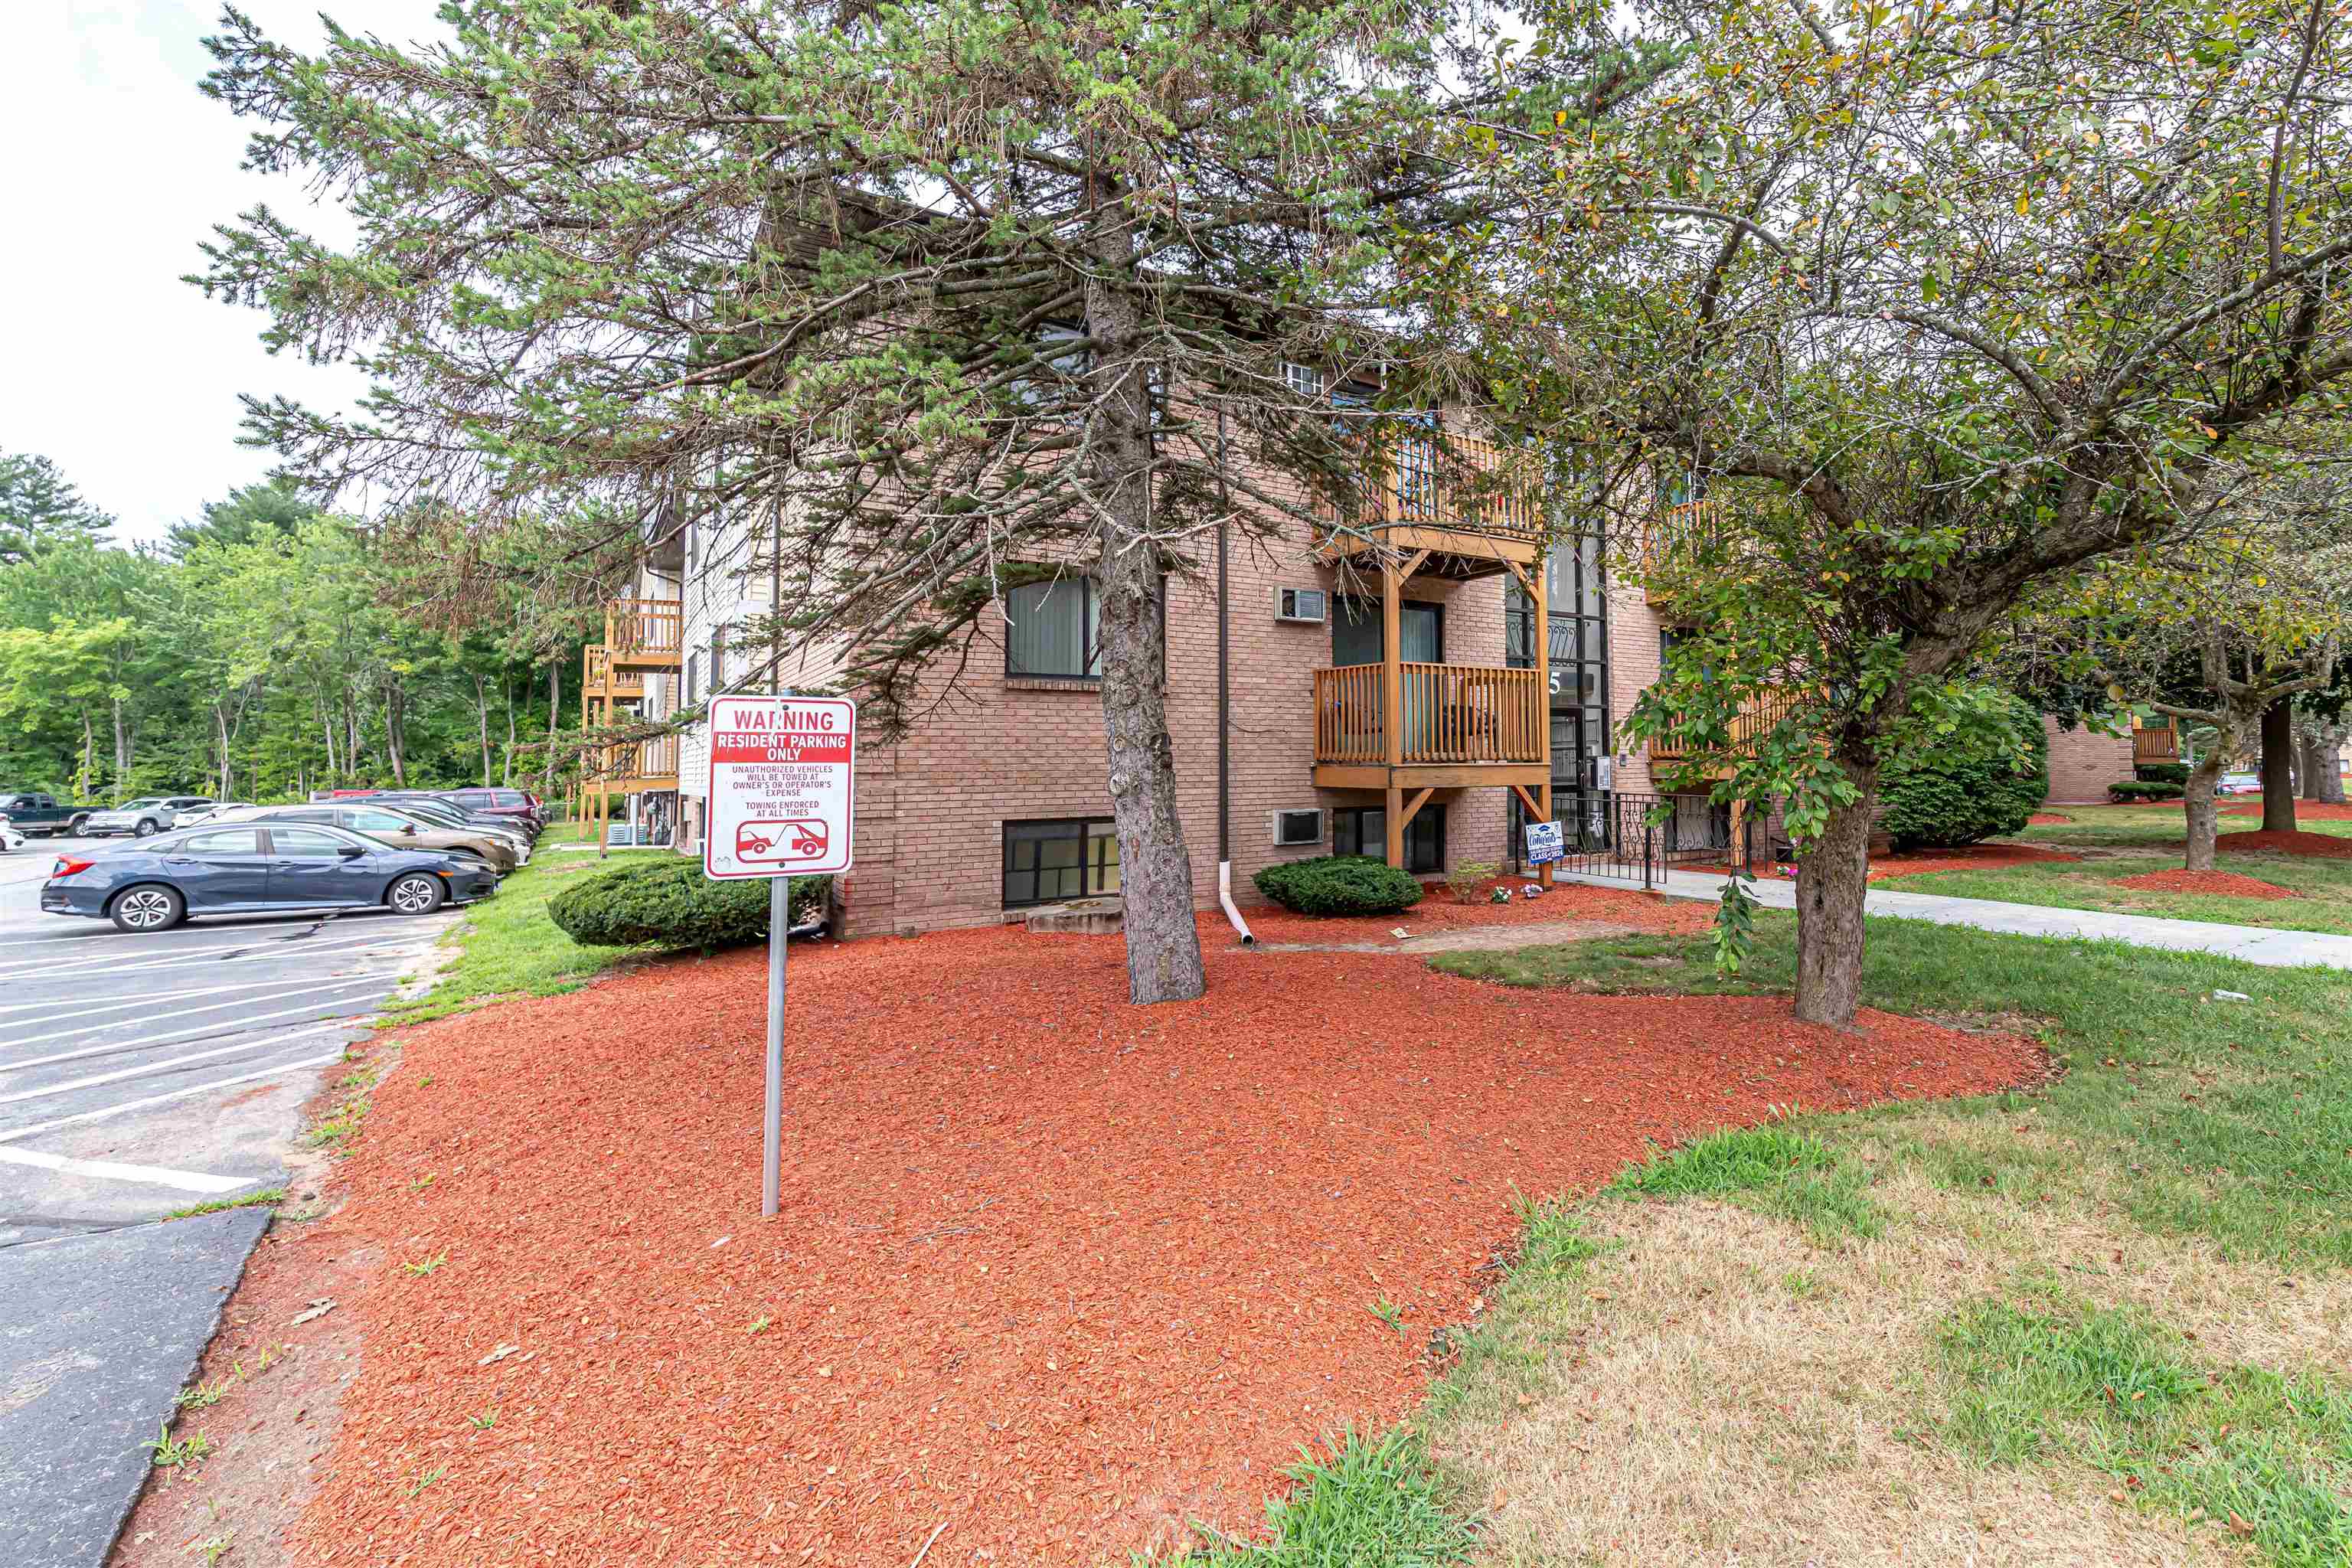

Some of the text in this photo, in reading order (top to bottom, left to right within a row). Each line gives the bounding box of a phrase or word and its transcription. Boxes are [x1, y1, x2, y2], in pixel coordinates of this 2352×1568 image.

[1550, 671, 1561, 694] 5
[717, 734, 846, 748] RESIDENT PARKING
[767, 748, 801, 760] ONLY
[733, 781, 769, 789] OWNER'S
